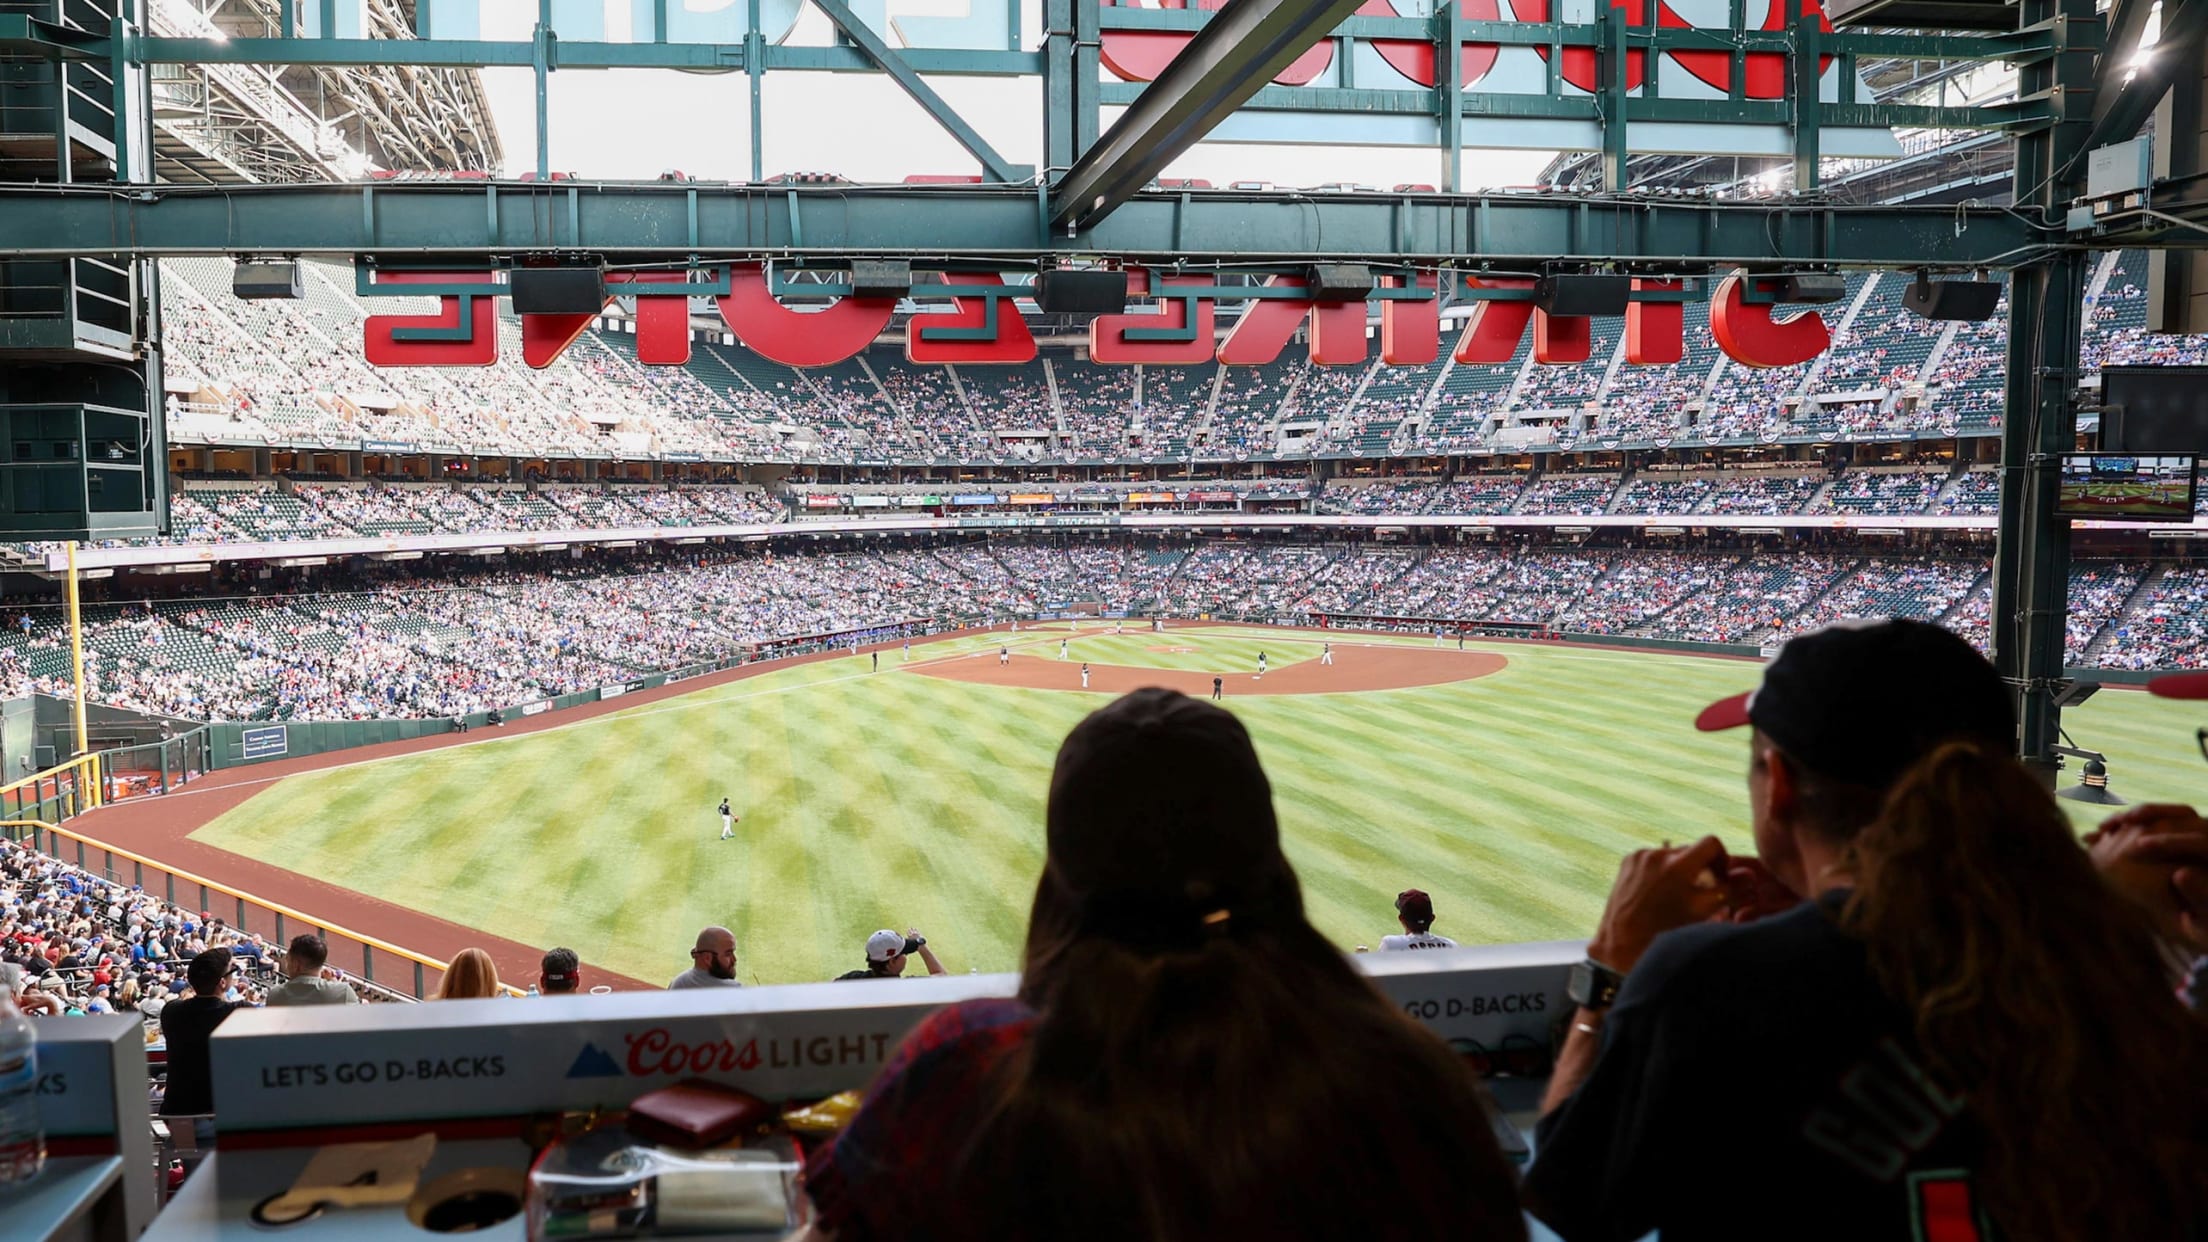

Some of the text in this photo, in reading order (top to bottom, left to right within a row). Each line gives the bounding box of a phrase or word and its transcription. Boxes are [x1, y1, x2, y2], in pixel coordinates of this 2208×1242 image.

[1404, 992, 1546, 1020] GO D-BACKS
[261, 1055, 506, 1088] LET'S GO D-BACKS
[625, 1028, 890, 1077] Coors LIGHT
[1802, 1037, 1968, 1182] GOL
